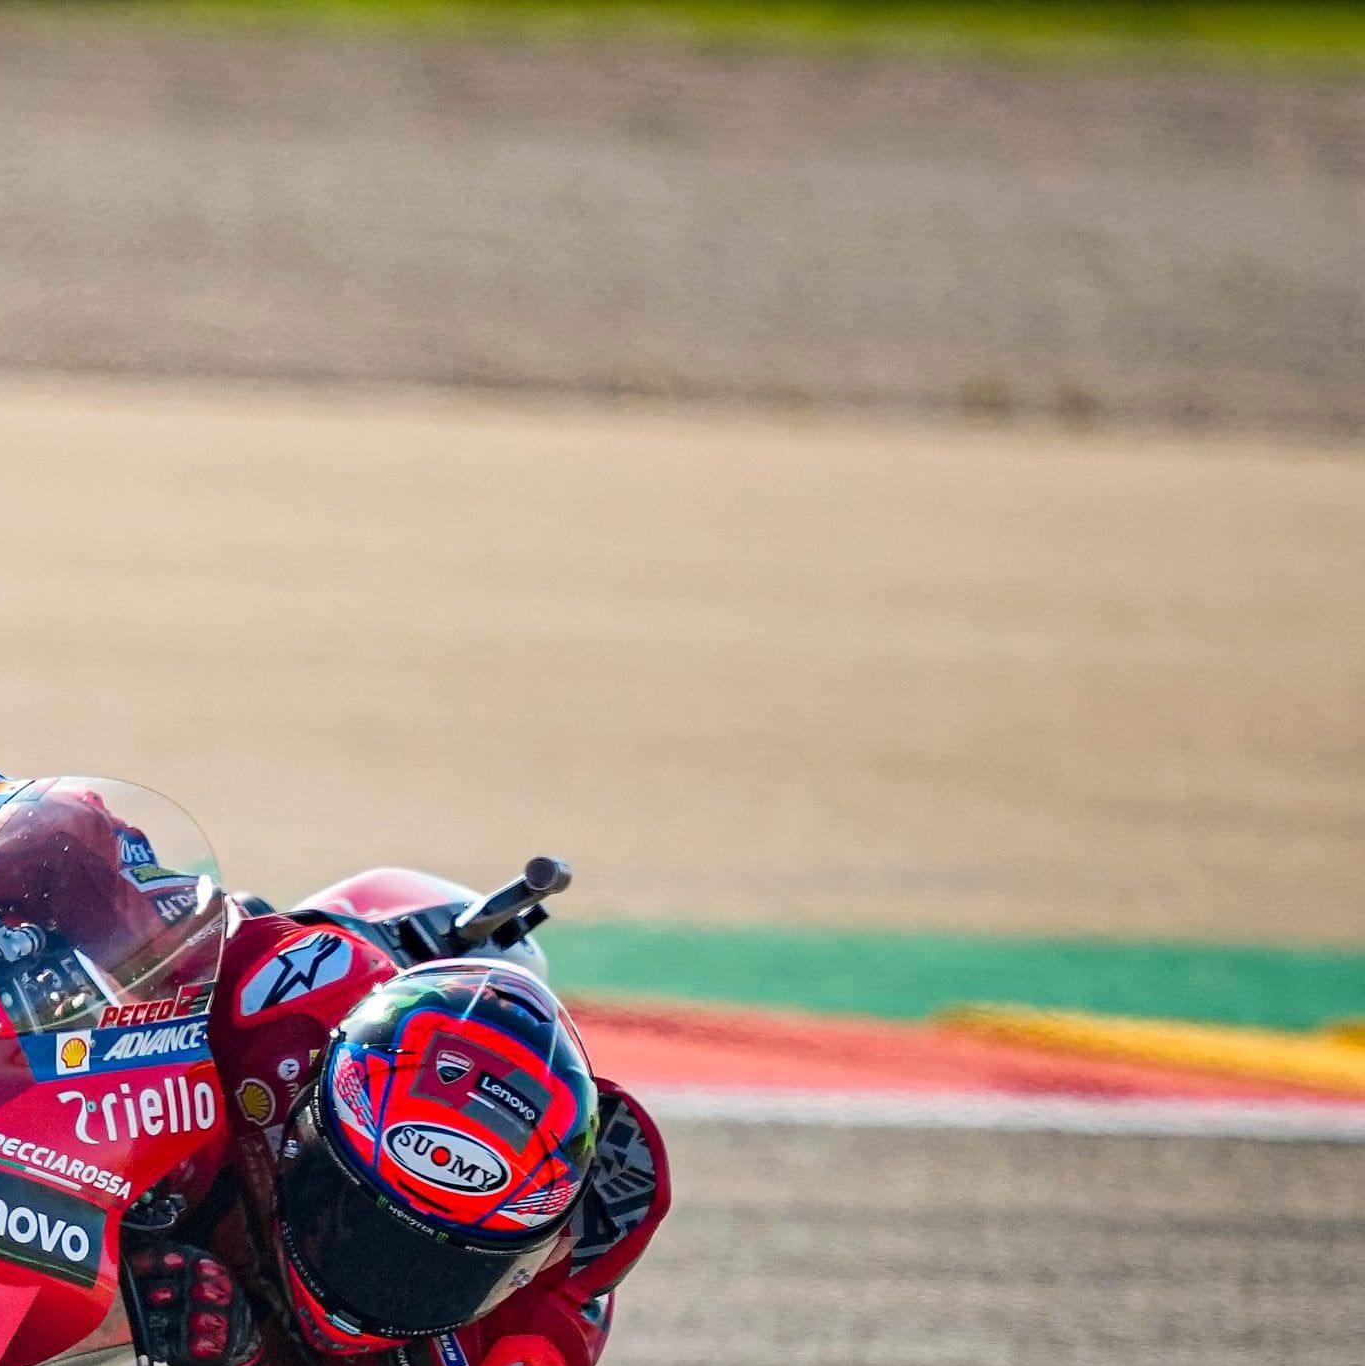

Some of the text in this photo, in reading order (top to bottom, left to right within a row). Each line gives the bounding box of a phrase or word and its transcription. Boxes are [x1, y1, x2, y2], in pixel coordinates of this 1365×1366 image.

[103, 1021, 208, 1061] ADVANCE
[101, 1077, 217, 1142] riello
[481, 1076, 536, 1121] Lenovo
[398, 1126, 504, 1190] SUOMY
